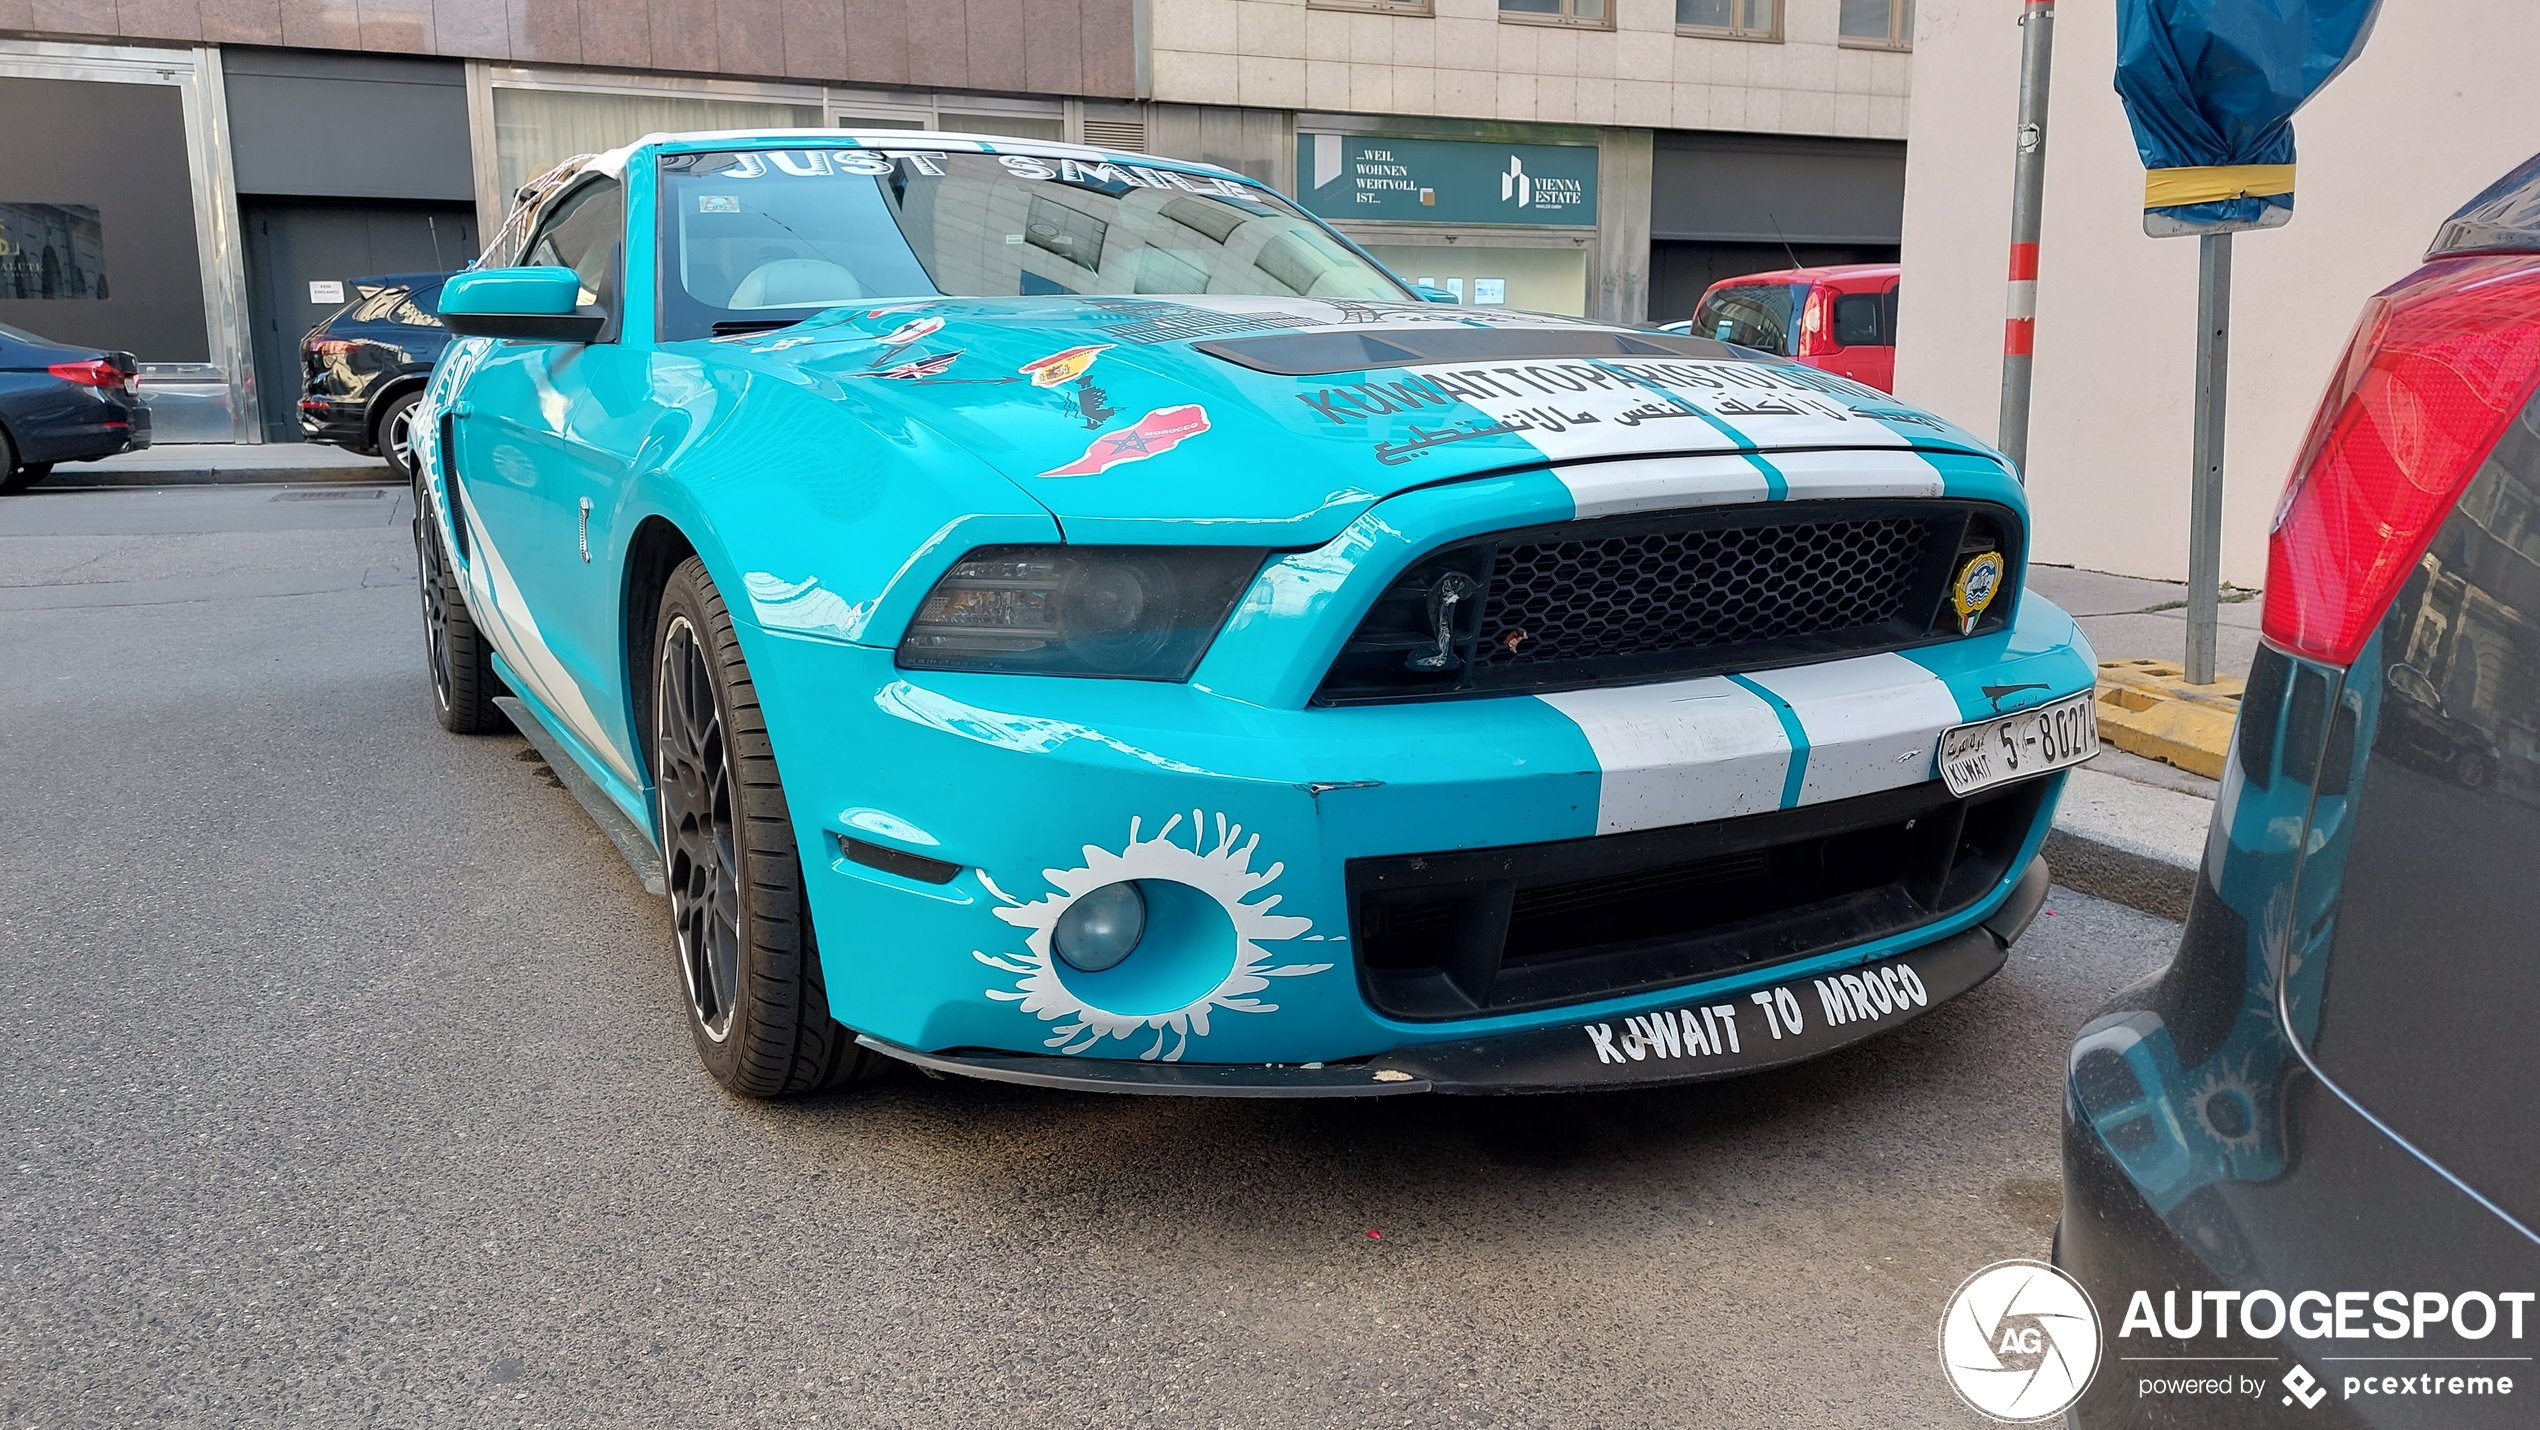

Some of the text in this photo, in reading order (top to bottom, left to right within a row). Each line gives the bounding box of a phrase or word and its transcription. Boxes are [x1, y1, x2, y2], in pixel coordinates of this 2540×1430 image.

[721, 149, 1261, 203] JUST SMILE
[1356, 164, 1407, 176] WOHNEN
[1356, 178, 1417, 190] WERTVOLL
[1534, 178, 1581, 191] VIENNA
[1356, 192, 1381, 203] IST...
[1535, 190, 1581, 203] ESTATE
[1296, 371, 1523, 424] KUWAIT
[1491, 366, 1588, 394] TO
[1555, 364, 1724, 391] PARIS
[1687, 365, 1778, 389] TO
[1613, 396, 1710, 427] النفس
[1143, 422, 1199, 437] MOROCCO
[1375, 412, 1536, 466] تستطيع
[1948, 754, 1991, 787] KUWAIT
[1584, 963, 1927, 1064] KUWAIT TO MROCO
